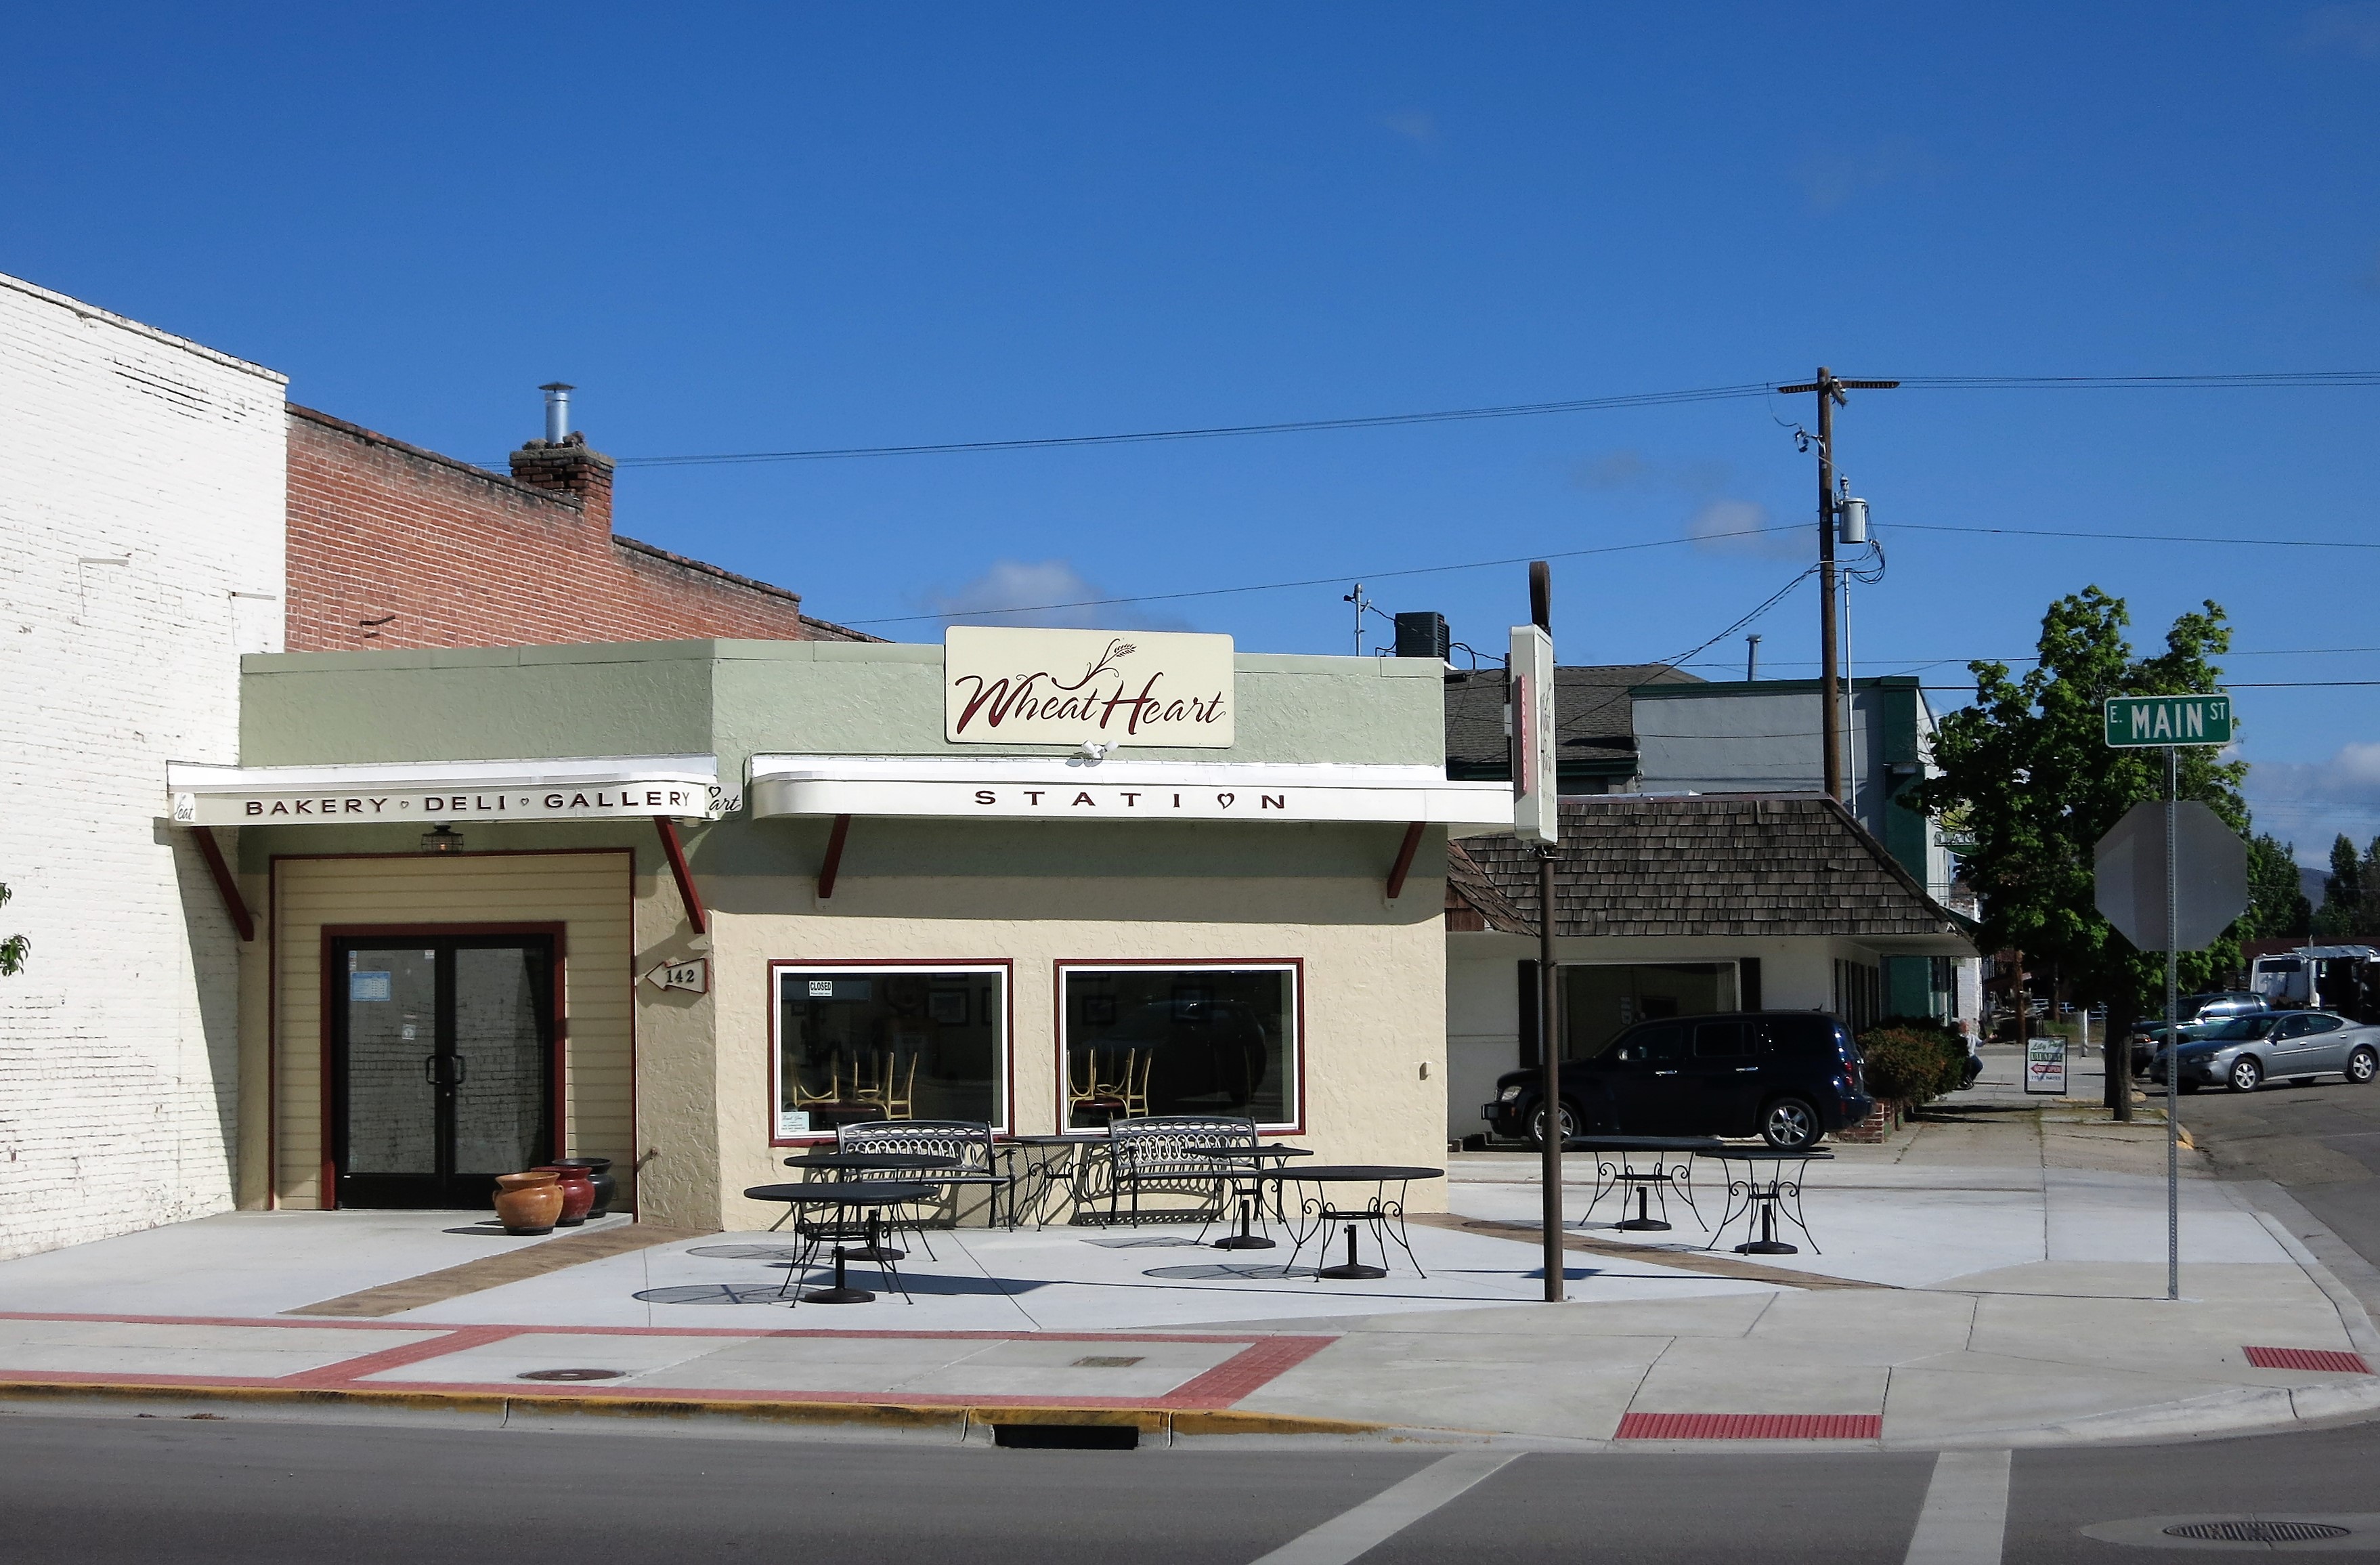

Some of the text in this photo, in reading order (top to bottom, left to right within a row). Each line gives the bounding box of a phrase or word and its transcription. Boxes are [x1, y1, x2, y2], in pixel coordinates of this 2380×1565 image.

[2110, 702, 2226, 739] E. MAIN ST
[245, 791, 690, 815] BAKERY DELI GALLERY
[709, 794, 741, 811] art
[666, 969, 695, 983] 142
[810, 982, 831, 991] CLOSED
